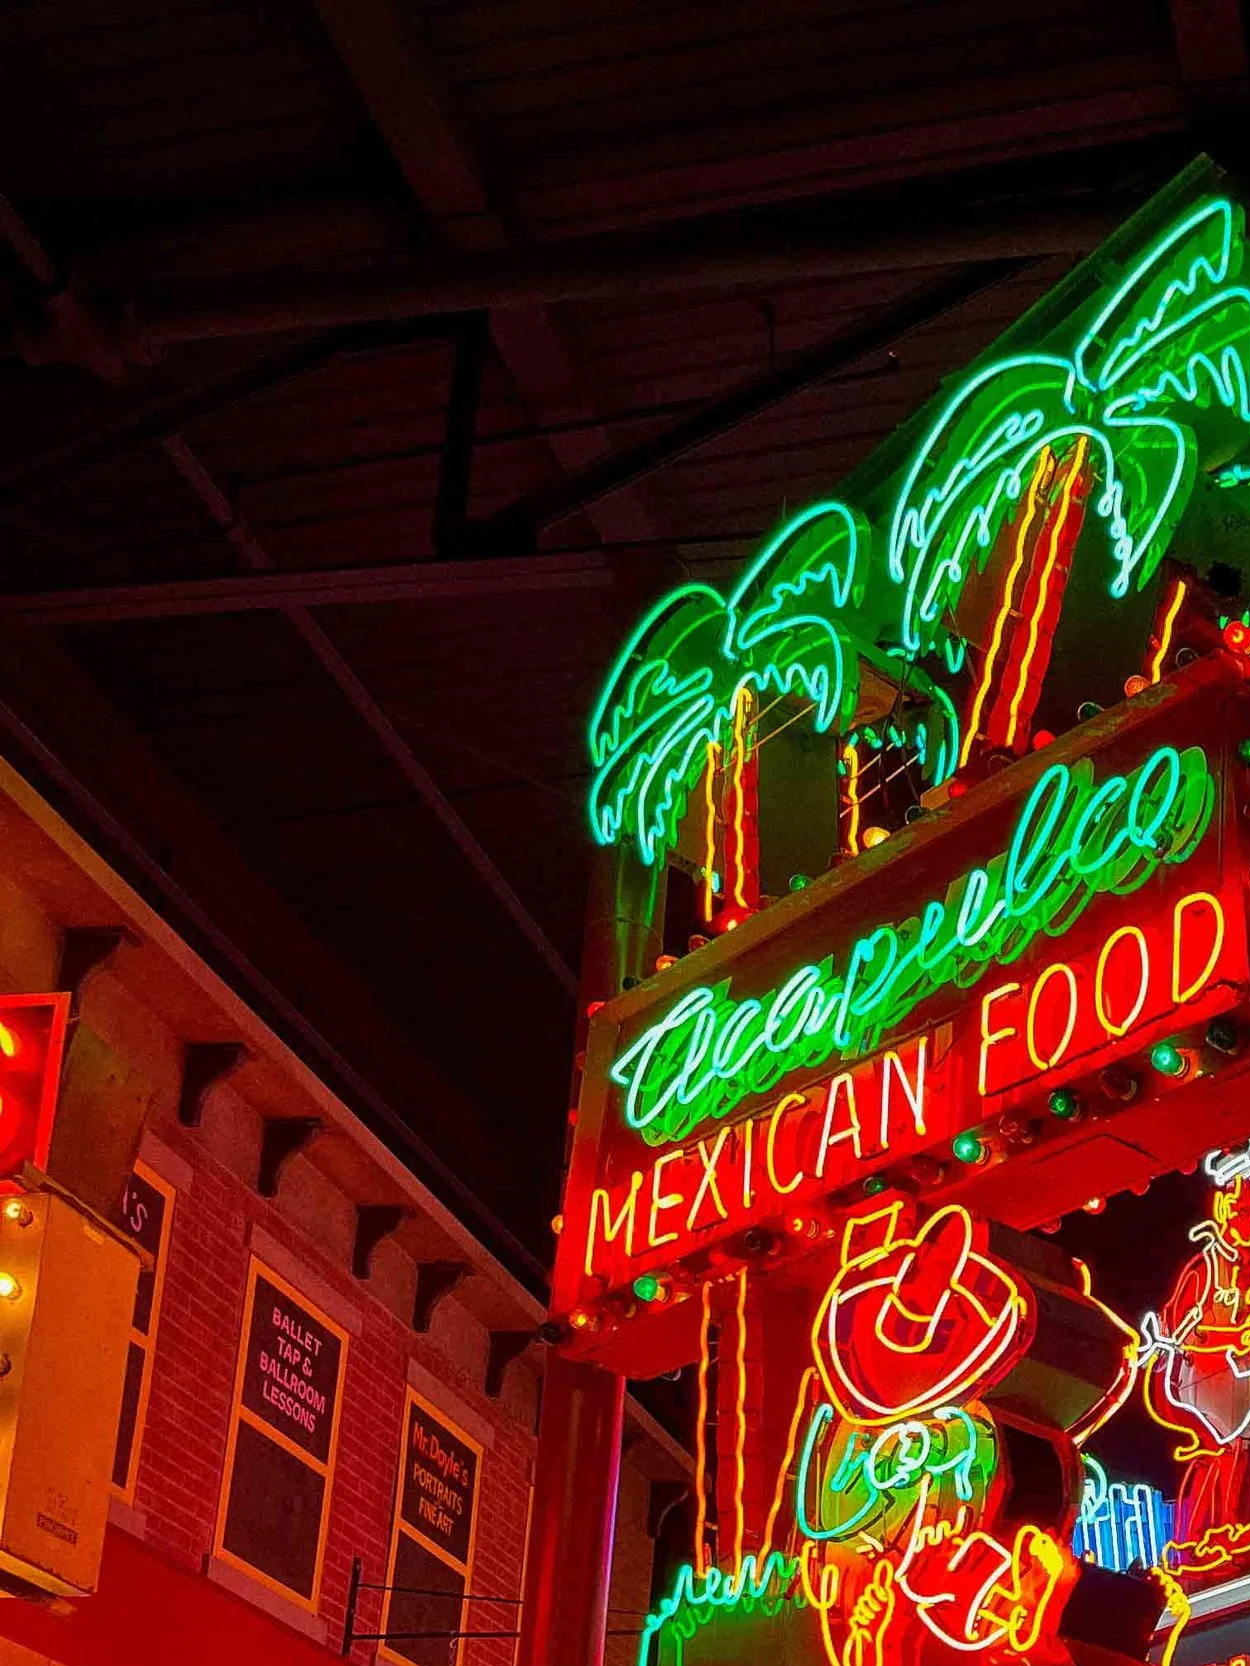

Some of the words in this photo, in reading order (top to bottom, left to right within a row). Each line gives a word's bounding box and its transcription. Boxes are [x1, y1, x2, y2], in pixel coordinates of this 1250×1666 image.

[584, 1036, 928, 1278] MEXICAN
[977, 892, 1225, 1096] FOOD
[272, 1307, 322, 1356] BALLET
[277, 1336, 301, 1365] TAP
[302, 1357, 313, 1377] &
[260, 1350, 326, 1414] BALLROOM
[262, 1380, 316, 1433] LESSONS
[413, 1462, 463, 1516] PORTRAITS
[418, 1496, 438, 1525] FINE
[436, 1510, 455, 1536] ART
